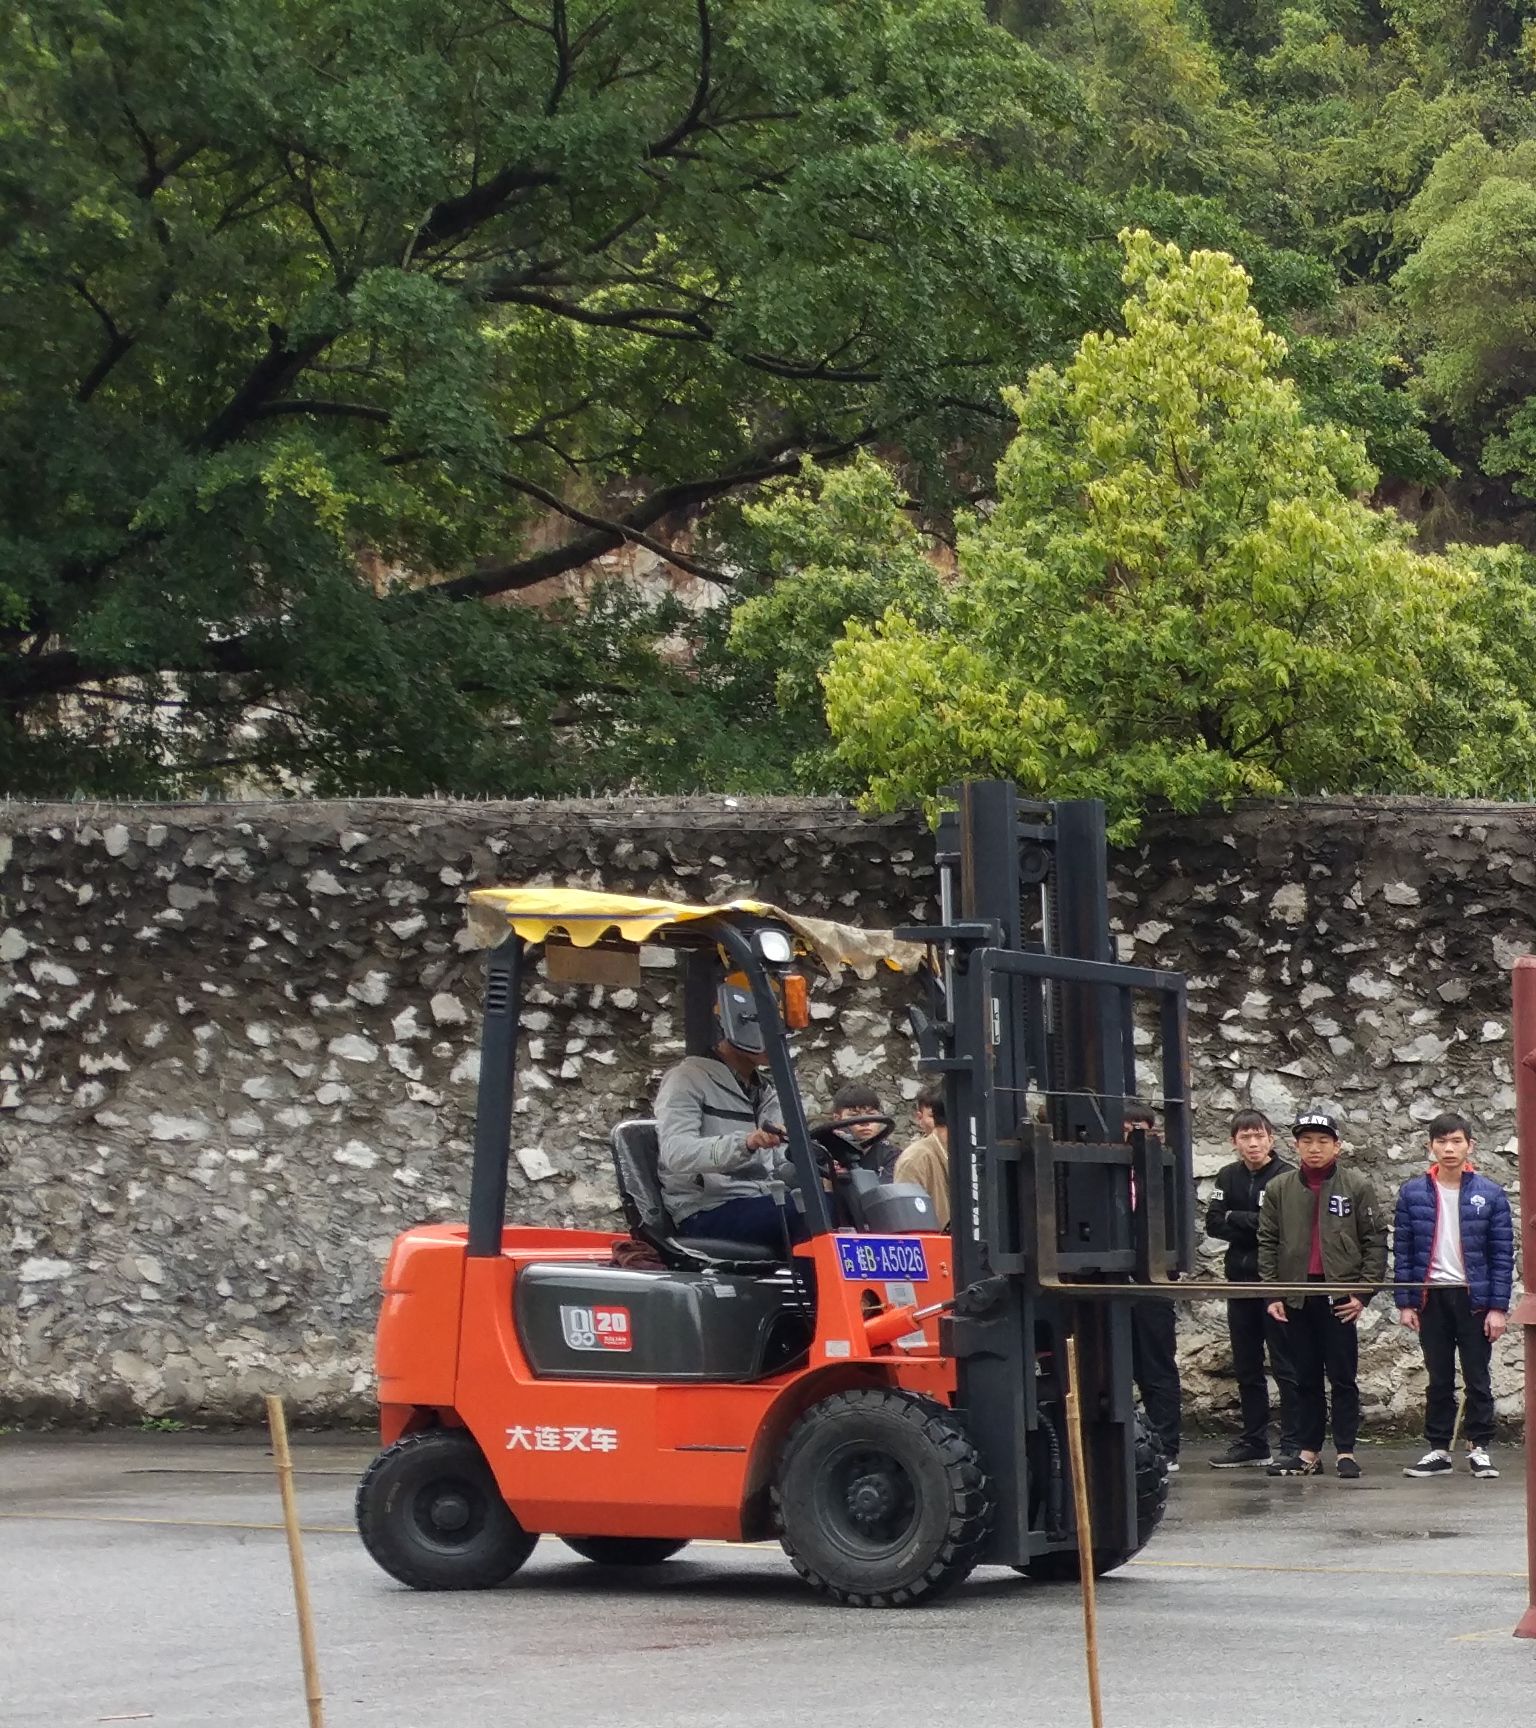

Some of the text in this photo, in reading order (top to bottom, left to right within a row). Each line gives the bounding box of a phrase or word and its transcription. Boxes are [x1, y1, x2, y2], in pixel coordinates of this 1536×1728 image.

[597, 1312, 627, 1332] 20
[505, 1425, 618, 1452] 大连叉车
